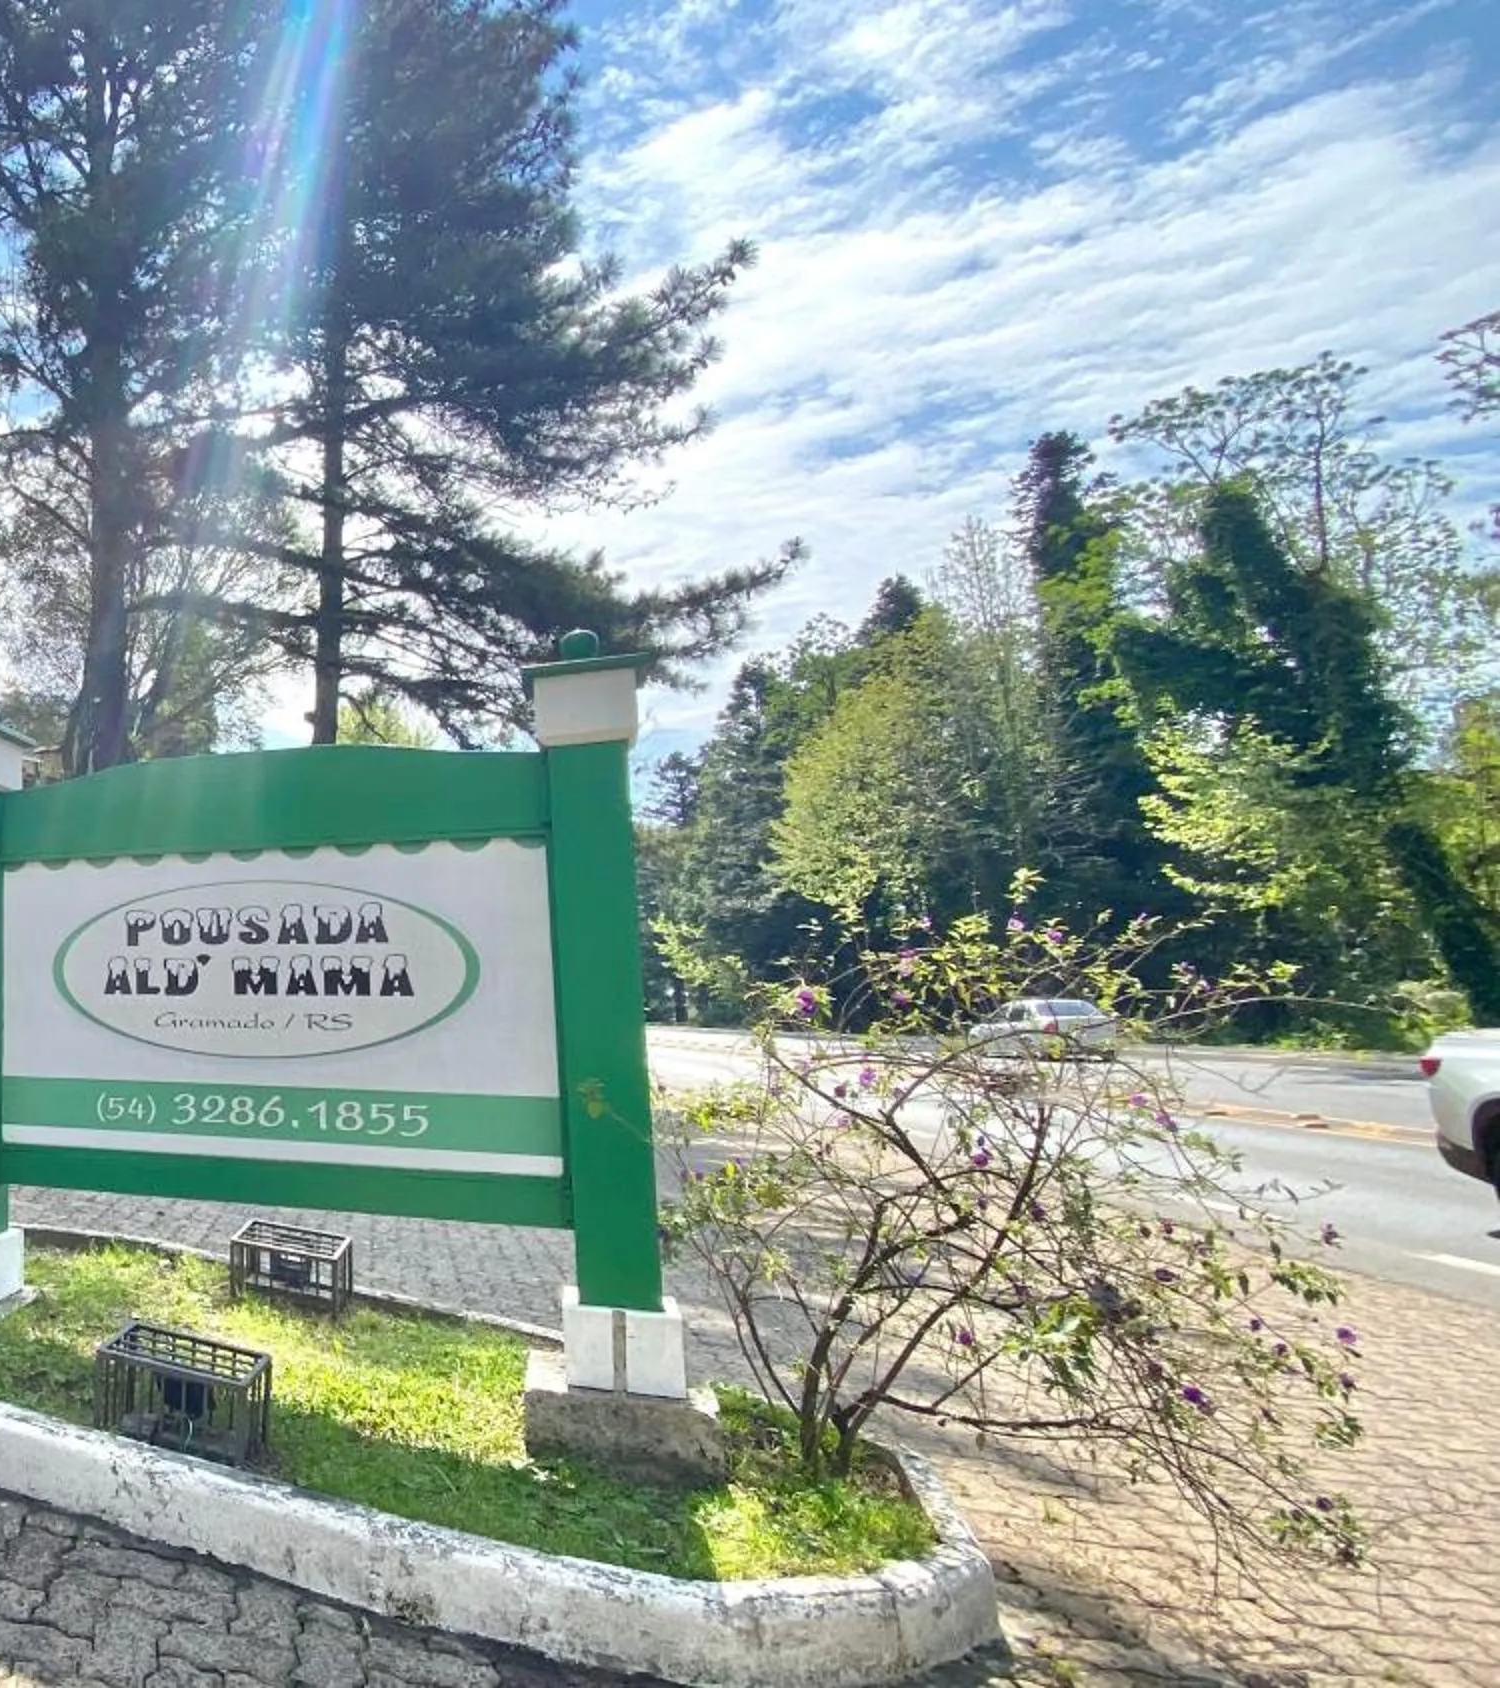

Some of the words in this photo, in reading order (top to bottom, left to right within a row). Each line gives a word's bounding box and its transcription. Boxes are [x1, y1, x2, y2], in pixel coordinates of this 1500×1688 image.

[125, 902, 389, 946] POUSADA
[232, 953, 415, 996] MAMA
[154, 1011, 275, 1031] Gramado
[306, 1013, 353, 1032] RS
[96, 1093, 157, 1124] (54)
[171, 1093, 429, 1137] 3286.1855
